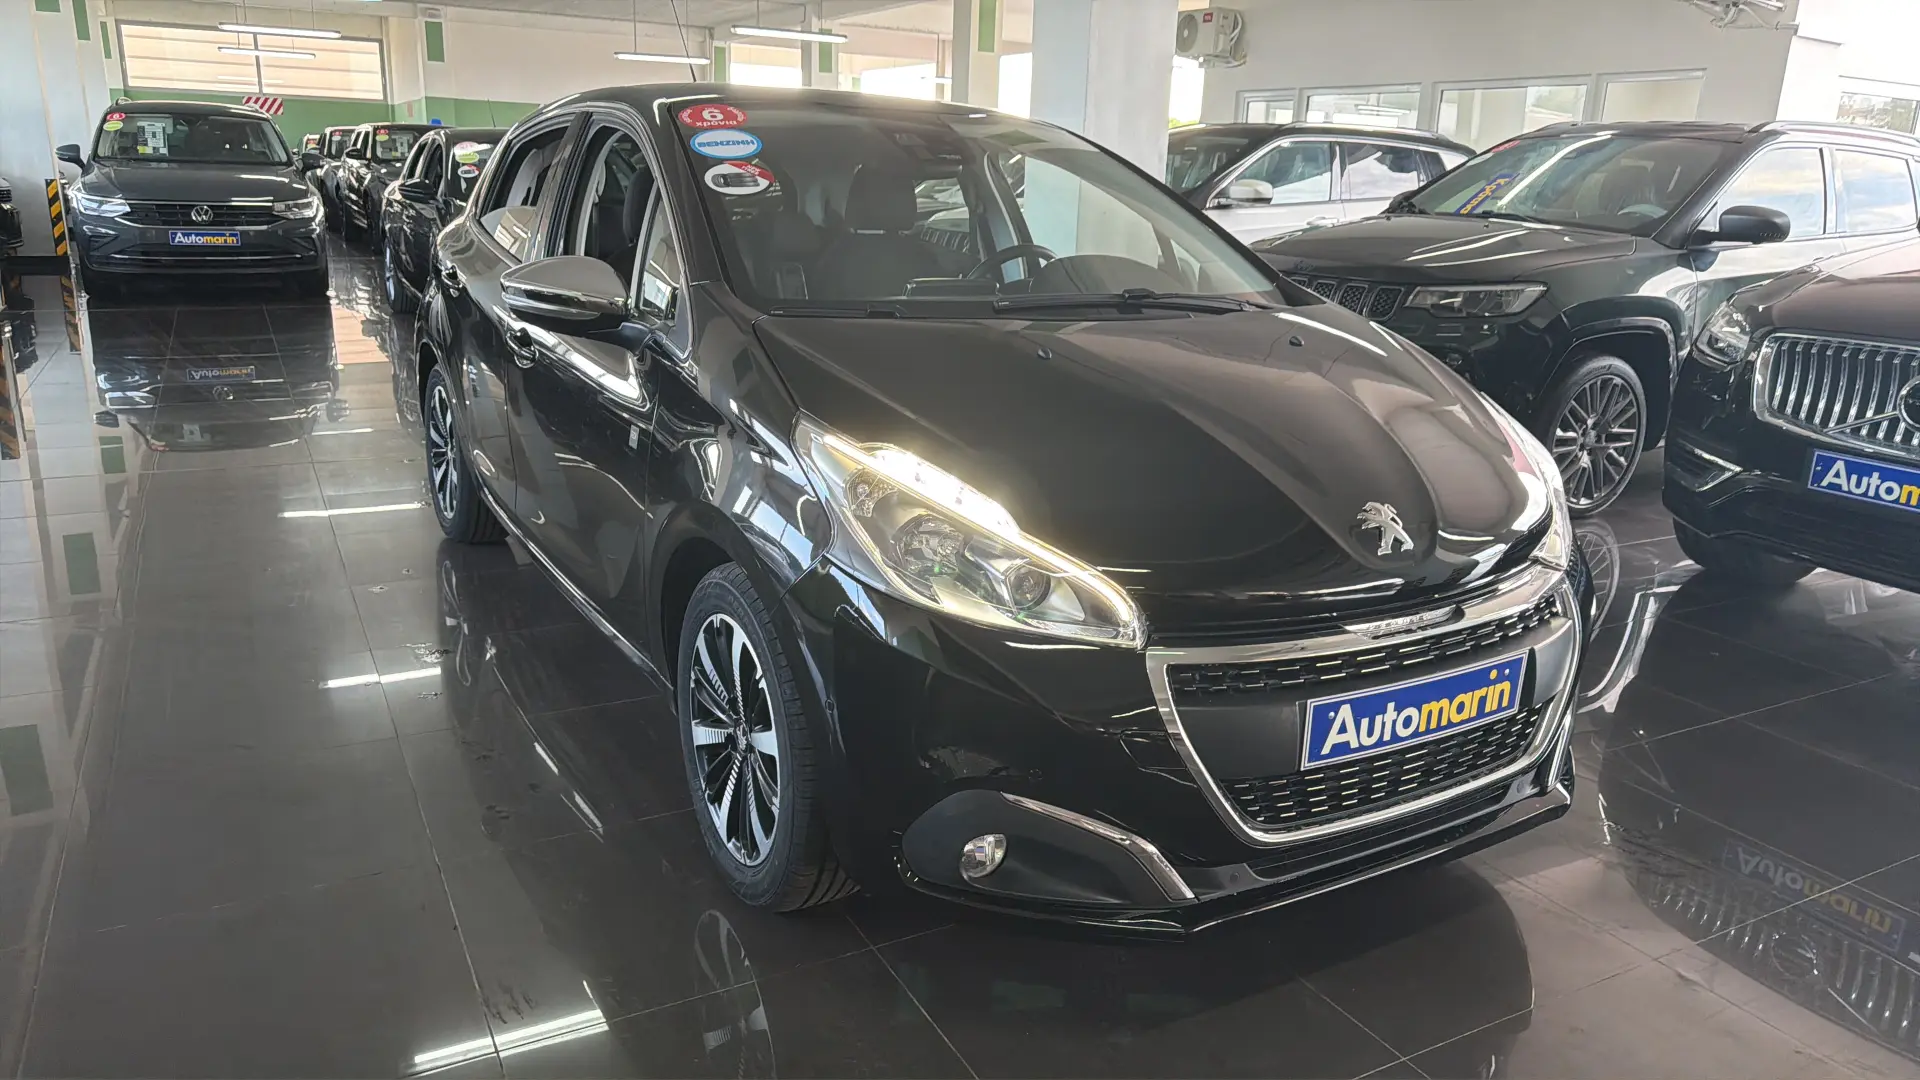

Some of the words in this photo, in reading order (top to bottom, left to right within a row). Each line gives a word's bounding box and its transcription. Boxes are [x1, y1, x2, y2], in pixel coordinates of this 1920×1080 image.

[702, 109, 724, 121] 6
[174, 232, 237, 244] Automarin
[1320, 669, 1511, 755] Automarin
